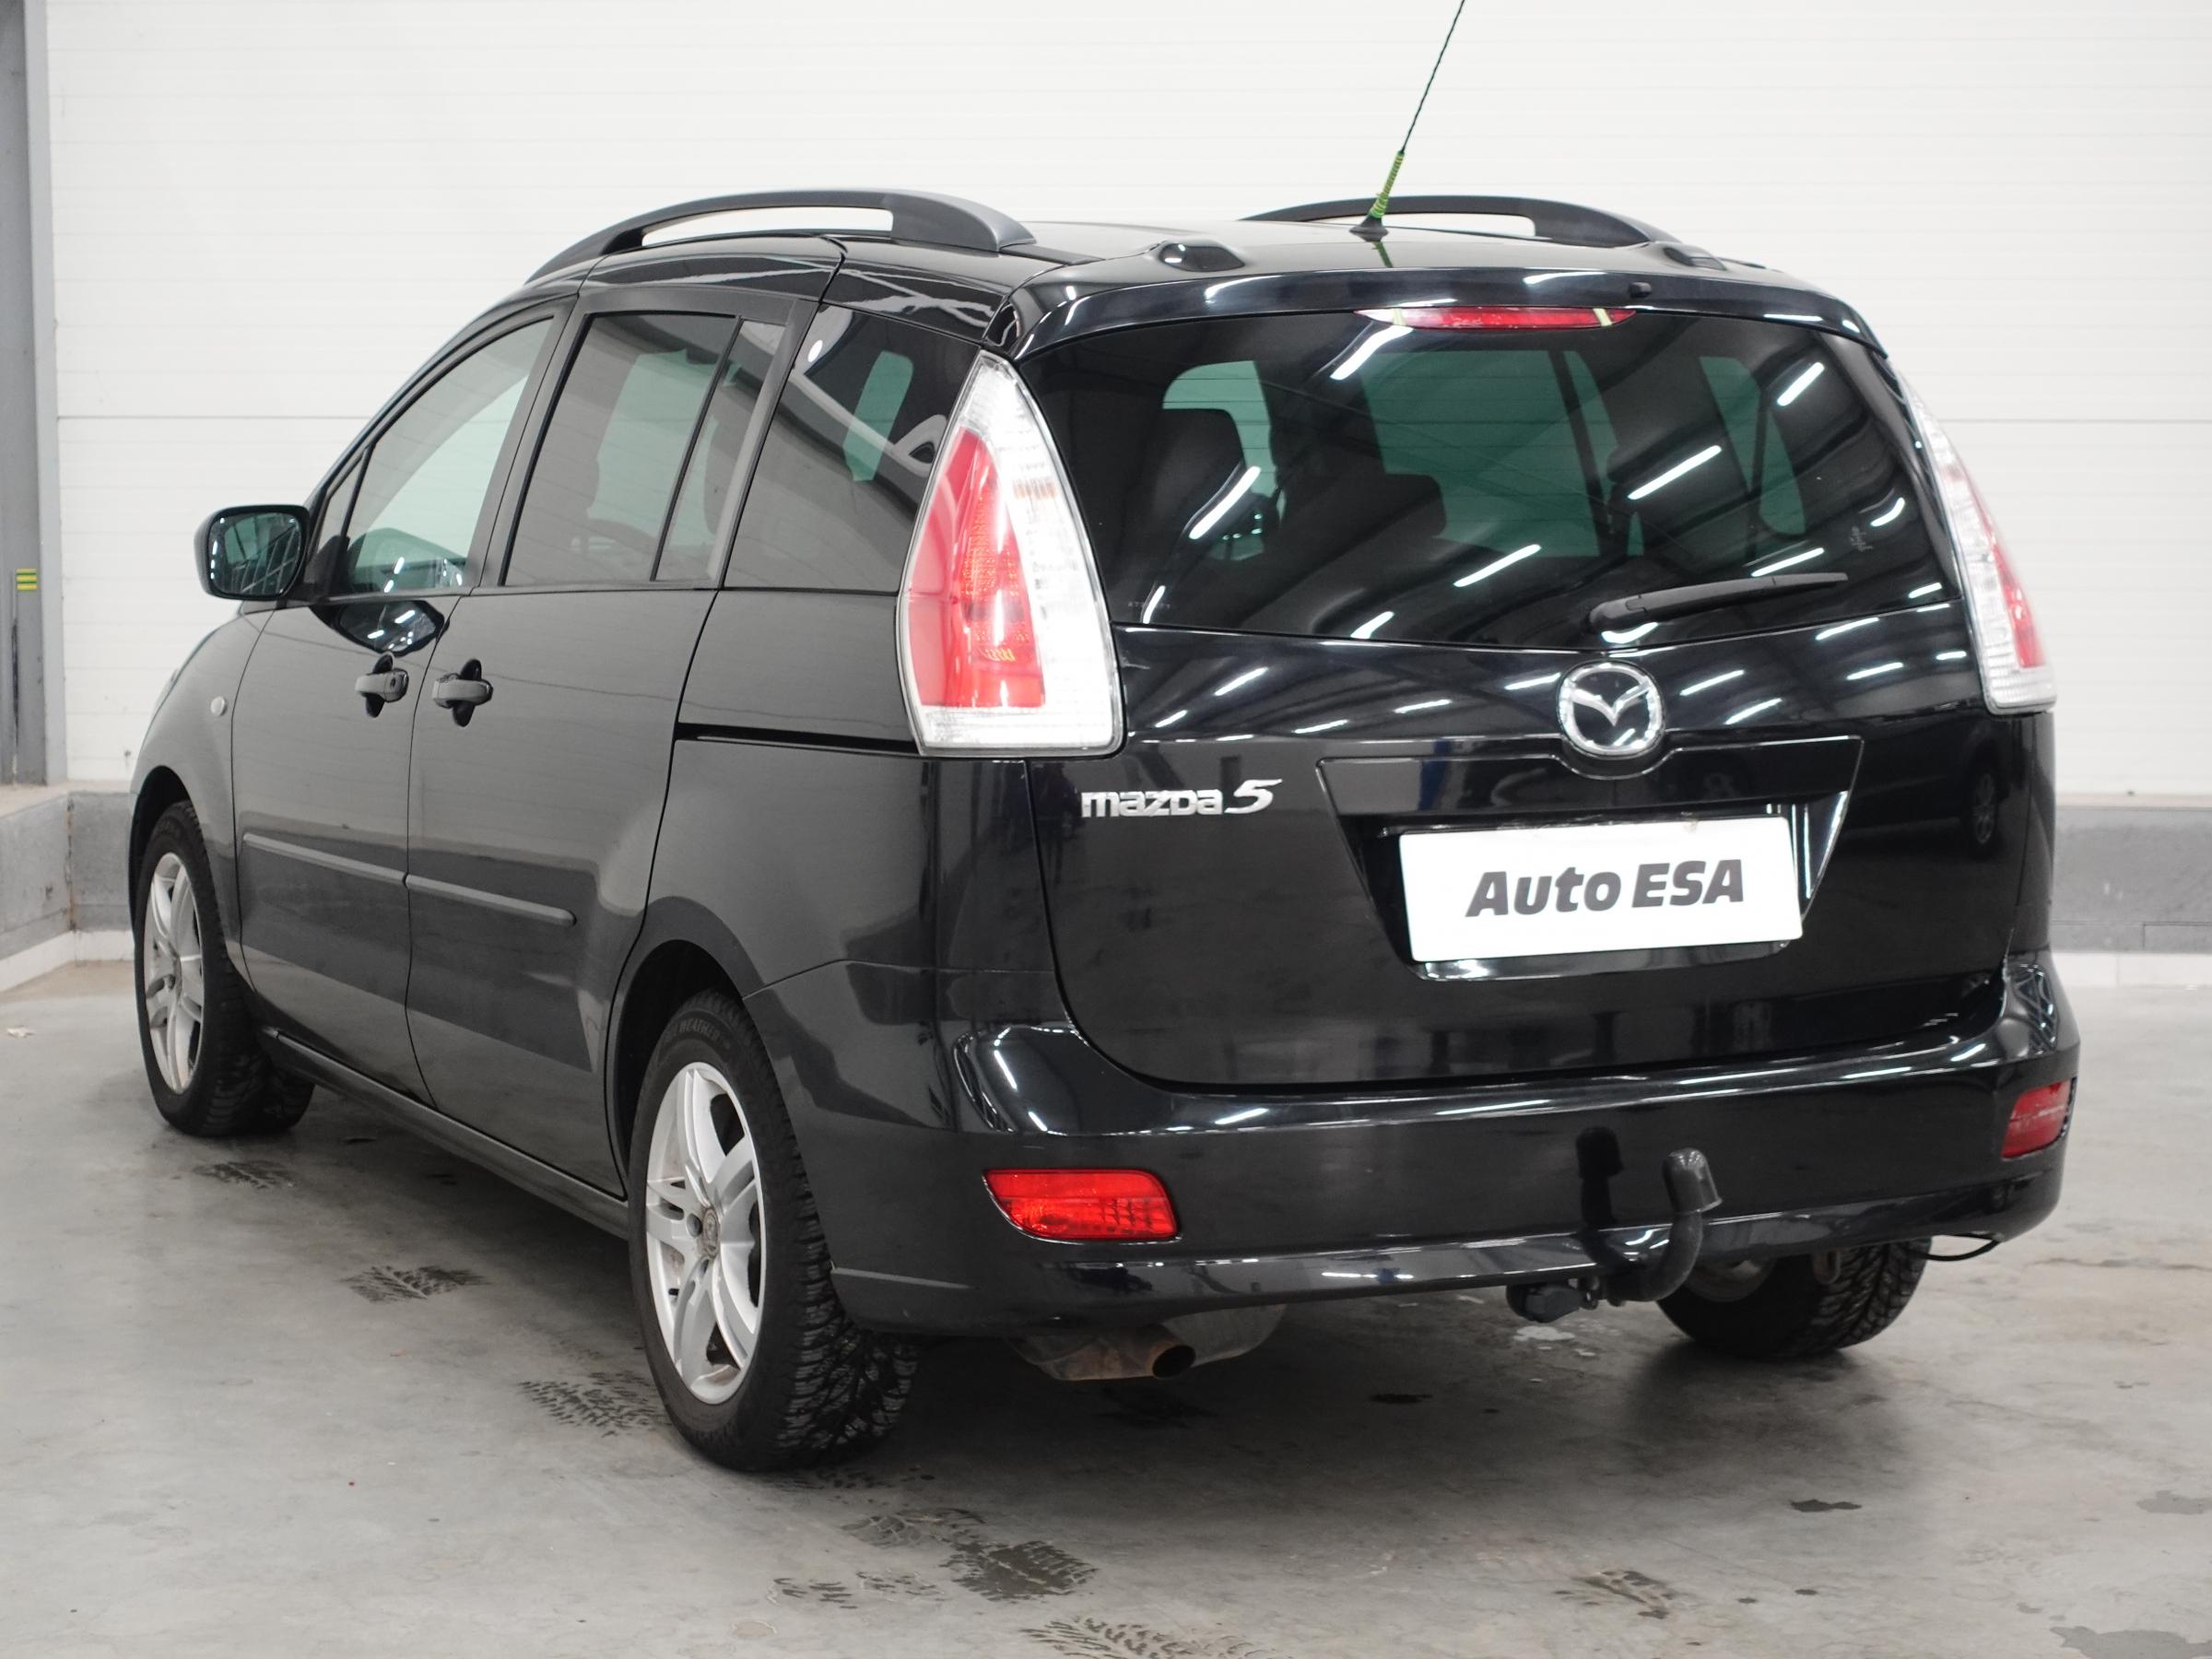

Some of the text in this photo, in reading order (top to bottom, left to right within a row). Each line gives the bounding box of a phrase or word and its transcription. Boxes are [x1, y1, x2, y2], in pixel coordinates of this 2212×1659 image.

[1224, 779, 1283, 814] 5
[1465, 859, 1745, 917] Auto ESA
